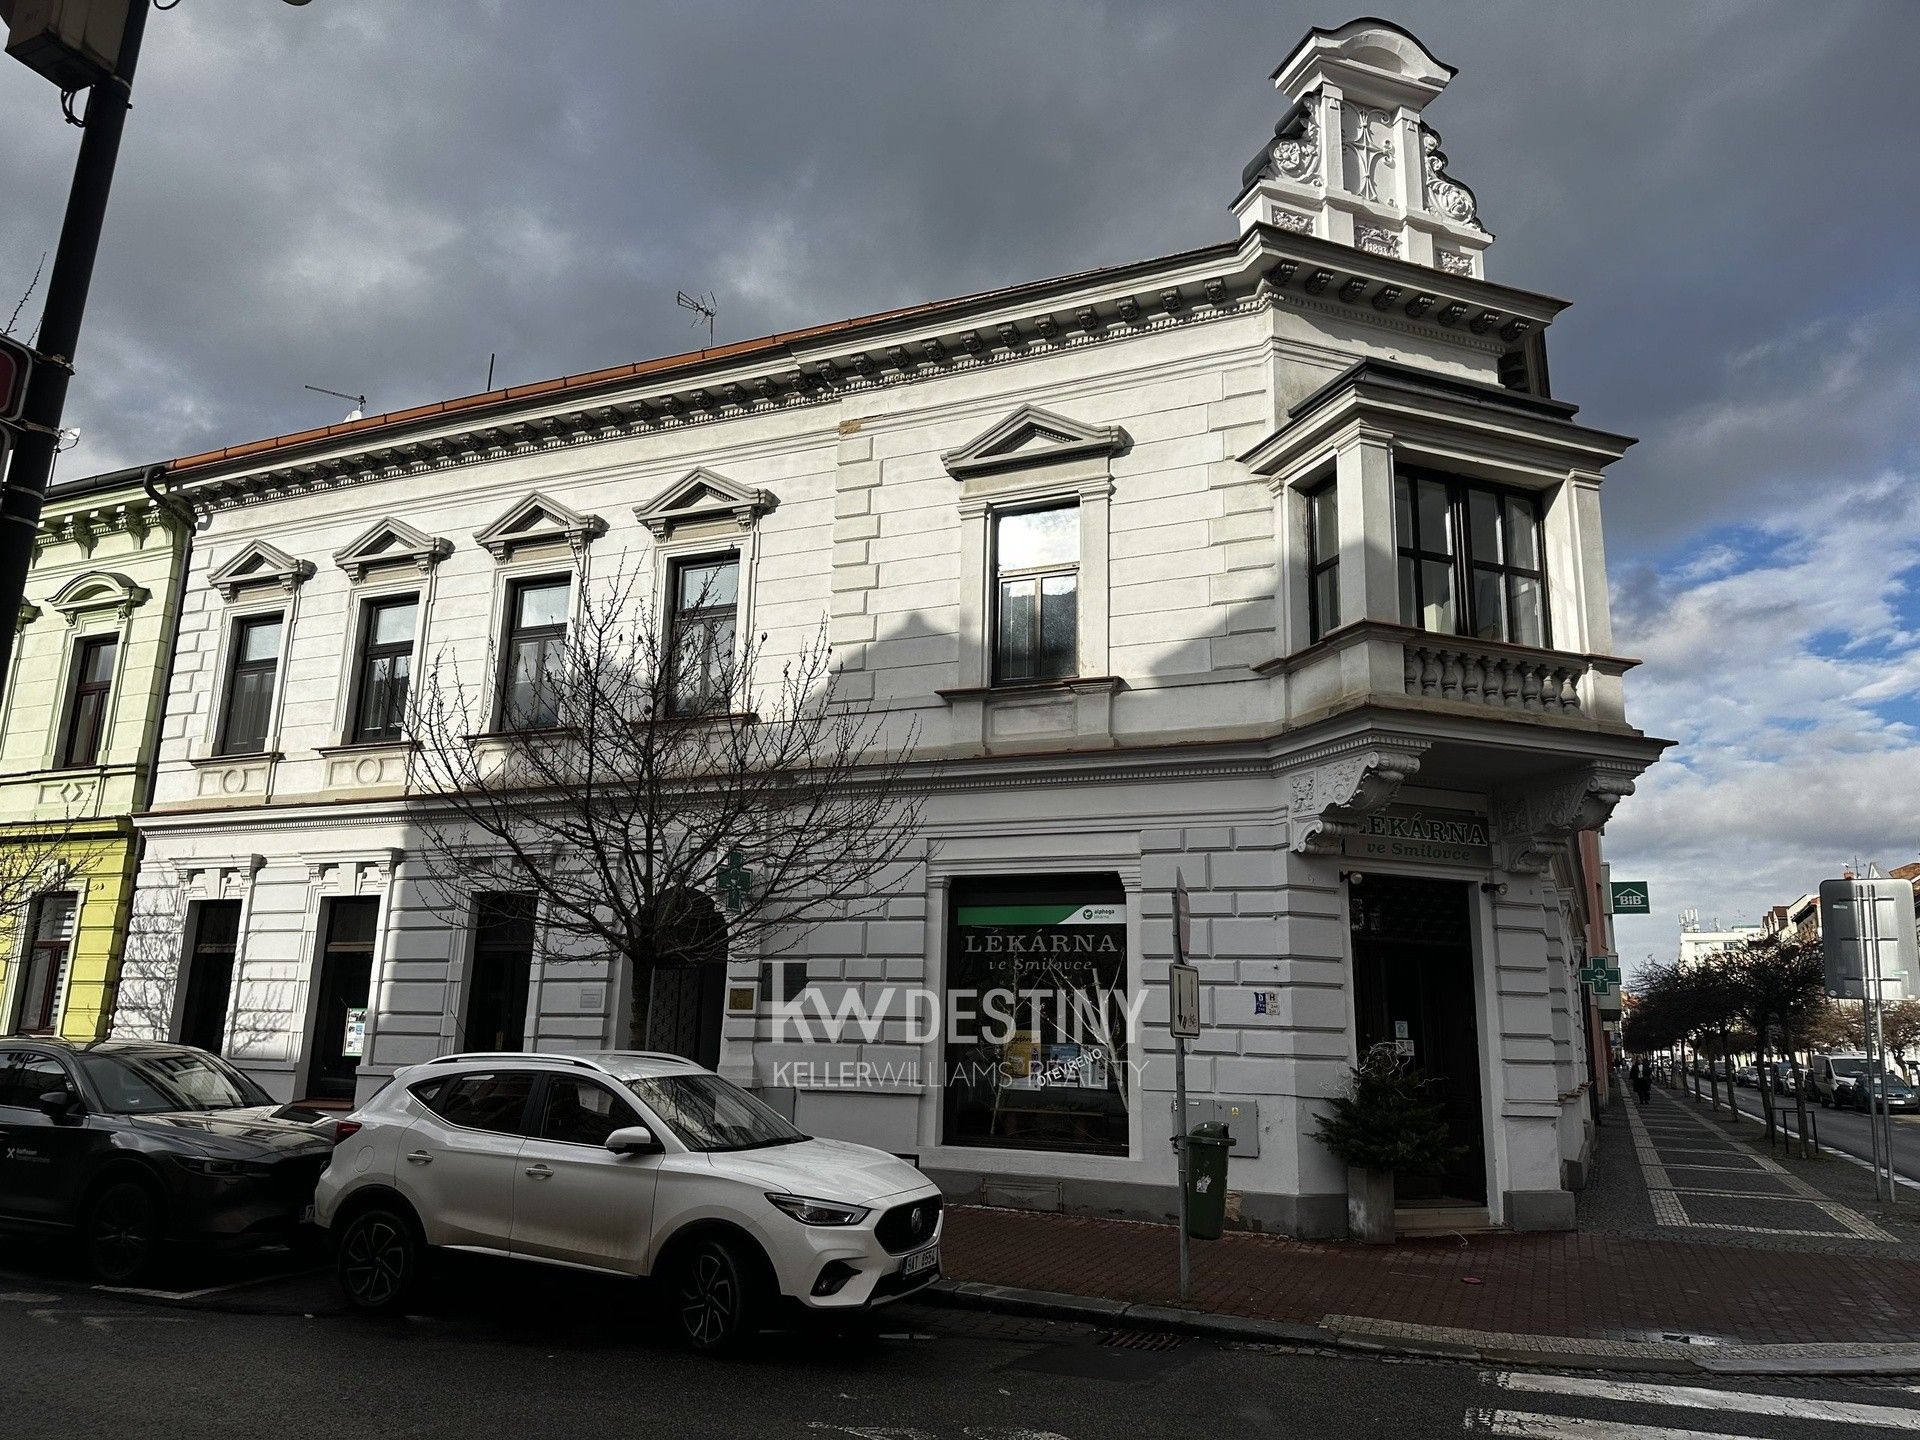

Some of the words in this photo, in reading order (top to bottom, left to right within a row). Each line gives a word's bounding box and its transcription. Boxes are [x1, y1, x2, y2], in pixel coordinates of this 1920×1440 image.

[1359, 810, 1488, 847] ÉKÁRNA
[1367, 844, 1385, 854] ve
[1620, 895, 1642, 905] BiB
[964, 929, 1118, 953] LÉKÁRNA
[988, 961, 1006, 970] ve
